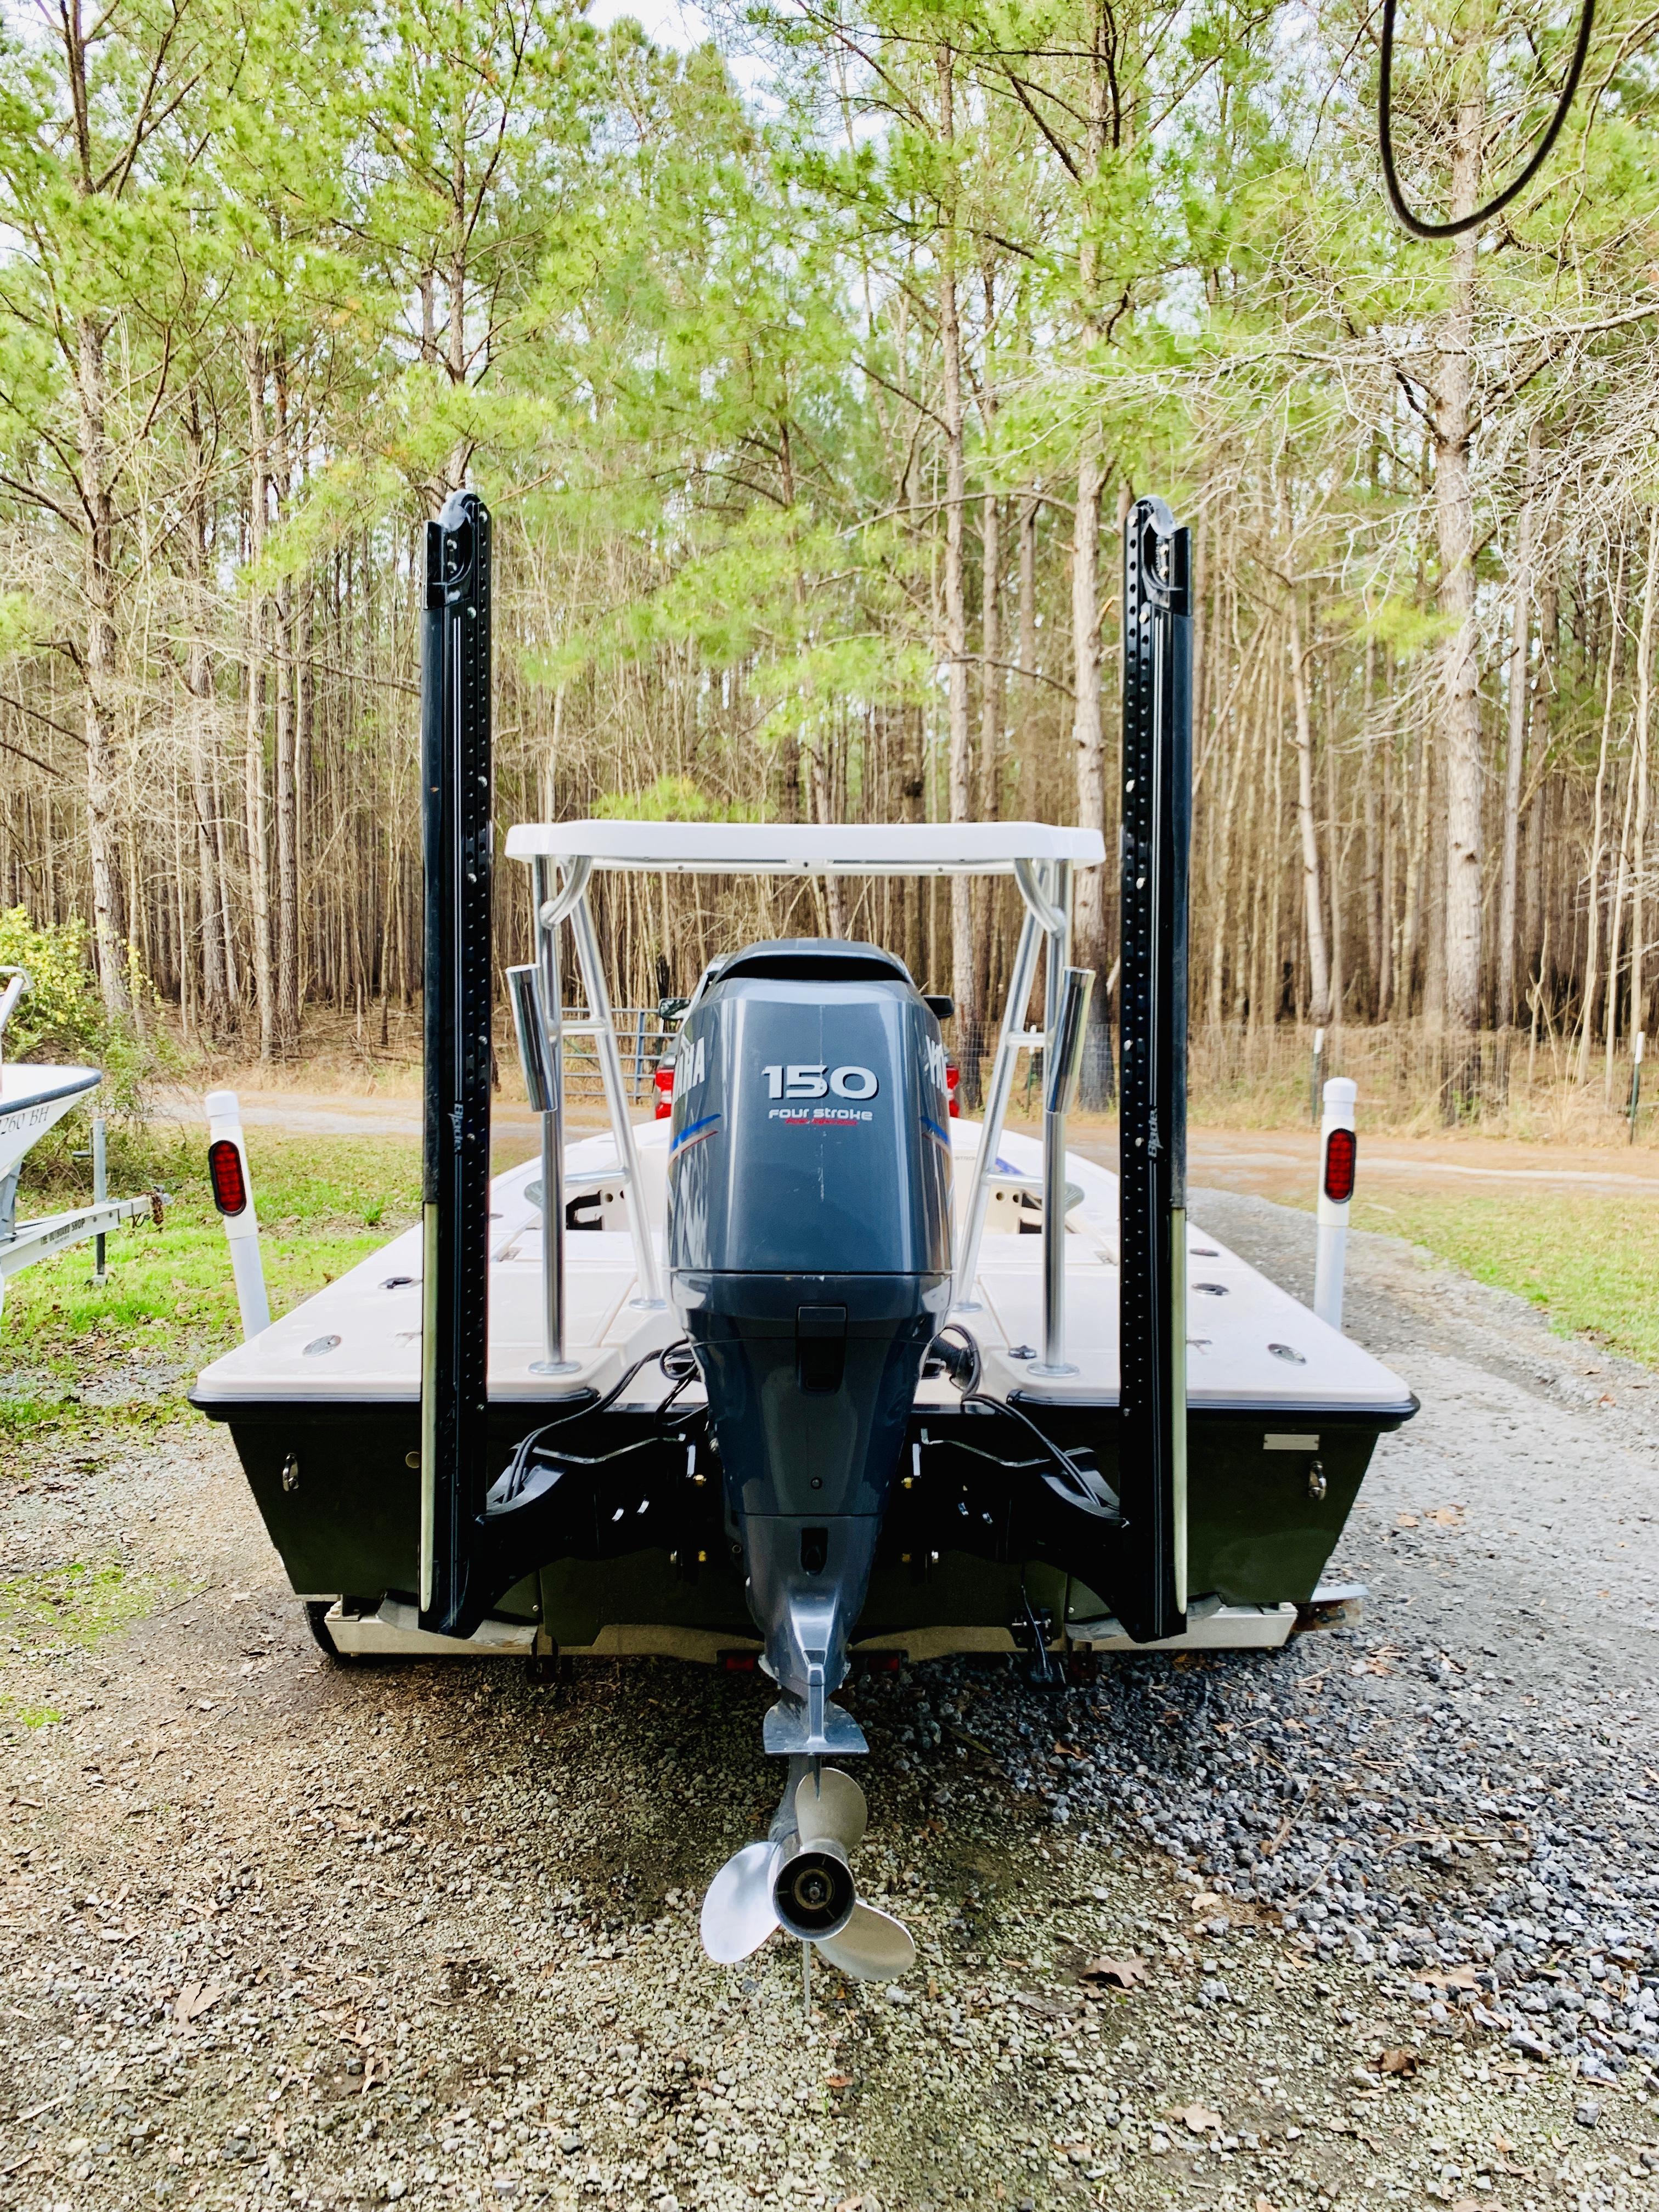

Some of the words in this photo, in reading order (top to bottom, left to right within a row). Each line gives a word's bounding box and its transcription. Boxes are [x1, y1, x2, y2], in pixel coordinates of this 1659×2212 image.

[761, 1065, 879, 1101] 150
[0, 1113, 25, 1136] 260
[29, 1106, 49, 1126] BH
[447, 1103, 464, 1152] Blade
[1148, 1108, 1164, 1158] Blade
